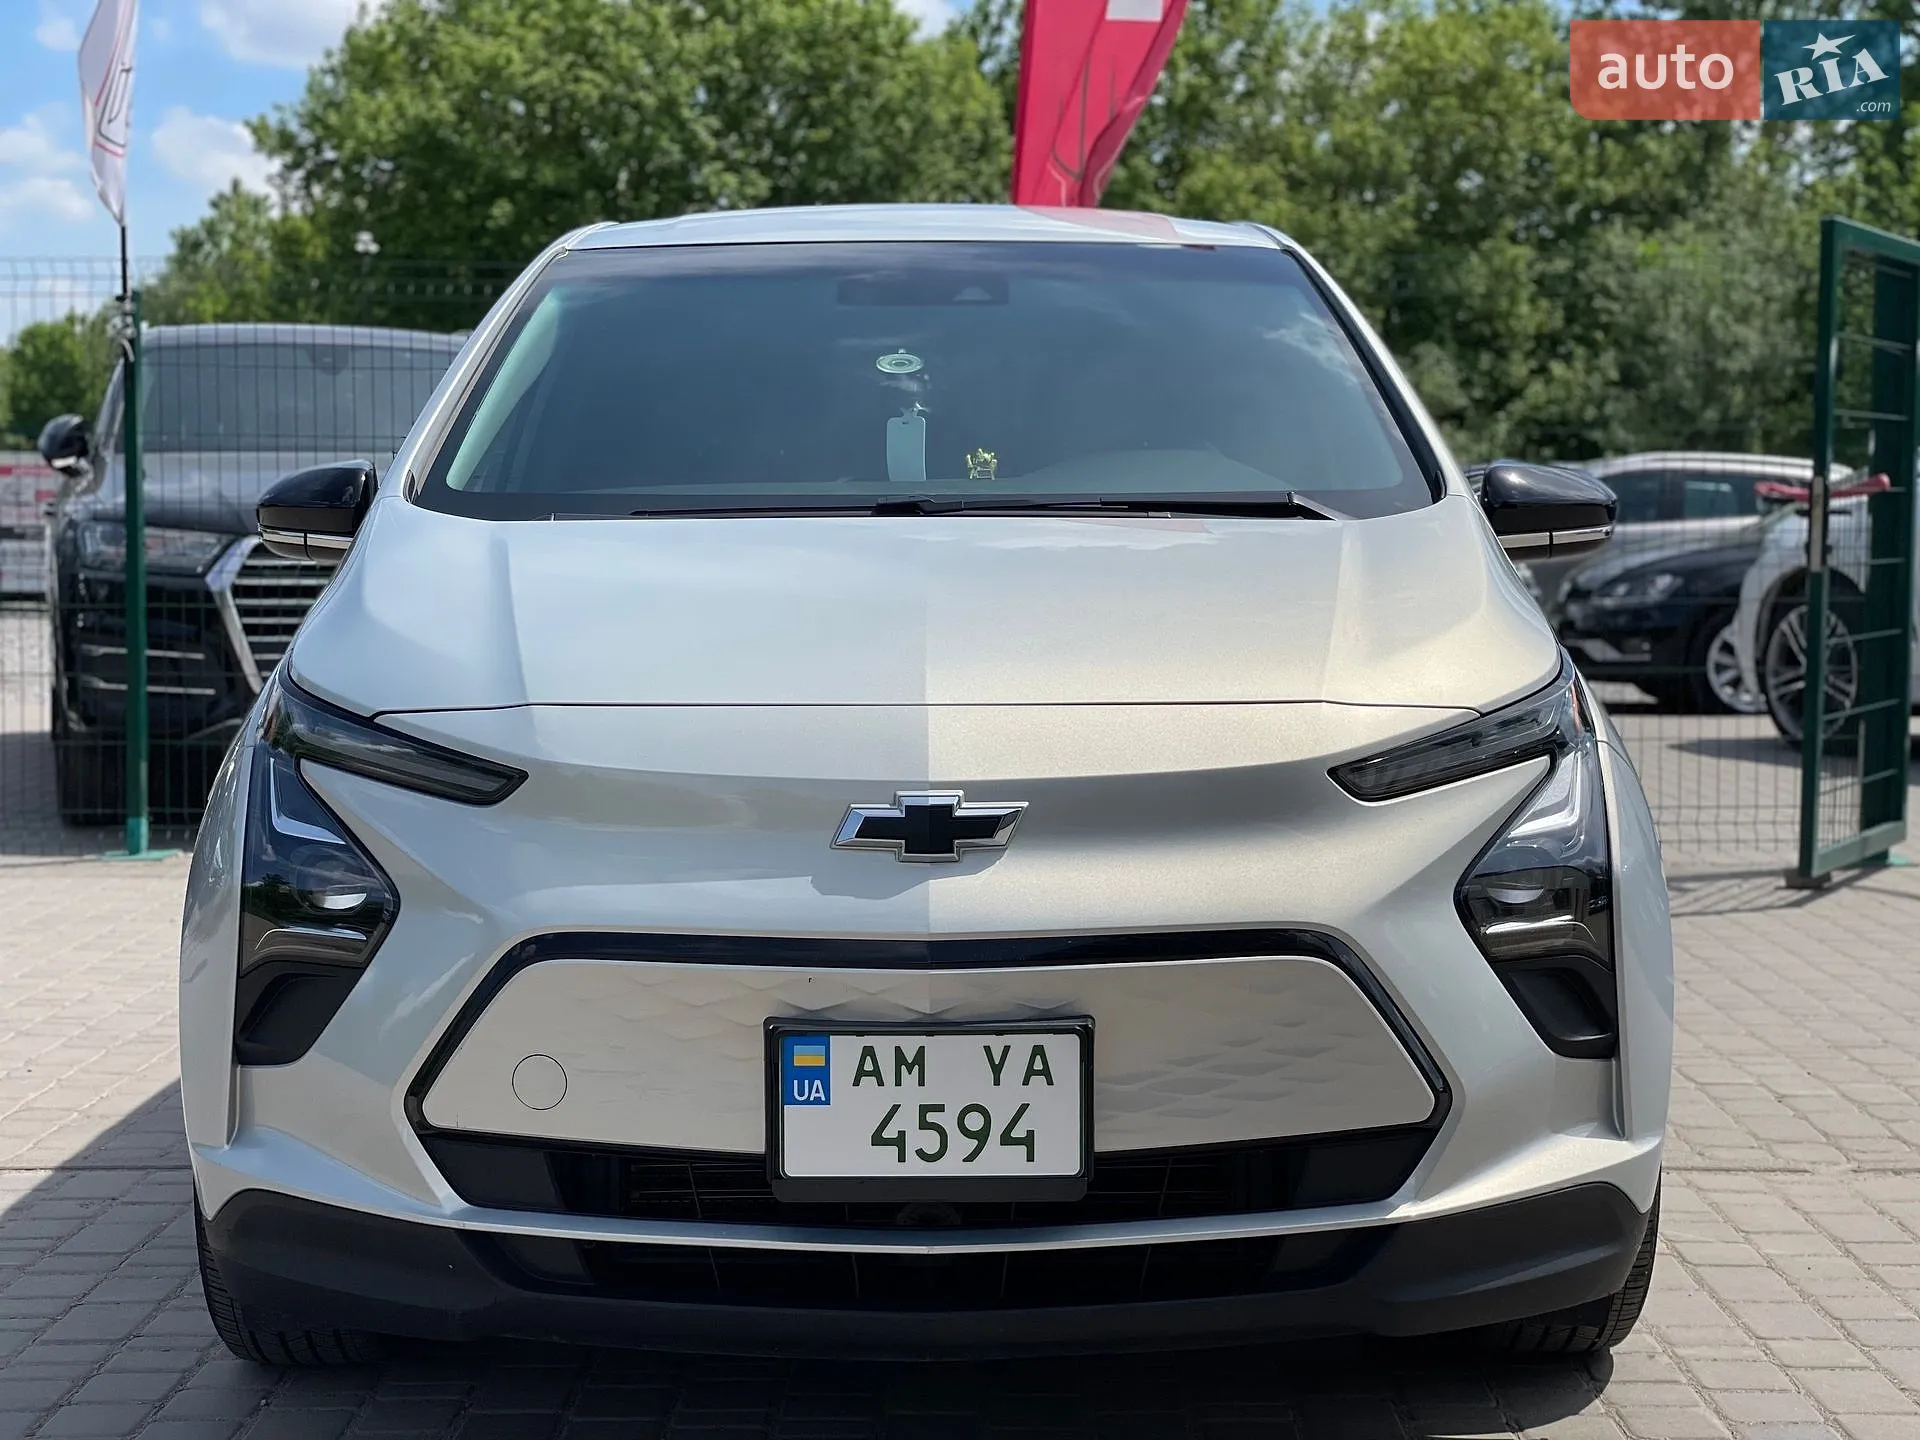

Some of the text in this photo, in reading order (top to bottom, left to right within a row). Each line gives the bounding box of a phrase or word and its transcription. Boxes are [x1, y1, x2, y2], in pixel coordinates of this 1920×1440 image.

[852, 1045, 1055, 1087] AM YA
[793, 1079, 826, 1101] UA
[870, 1103, 1036, 1163] 4594
